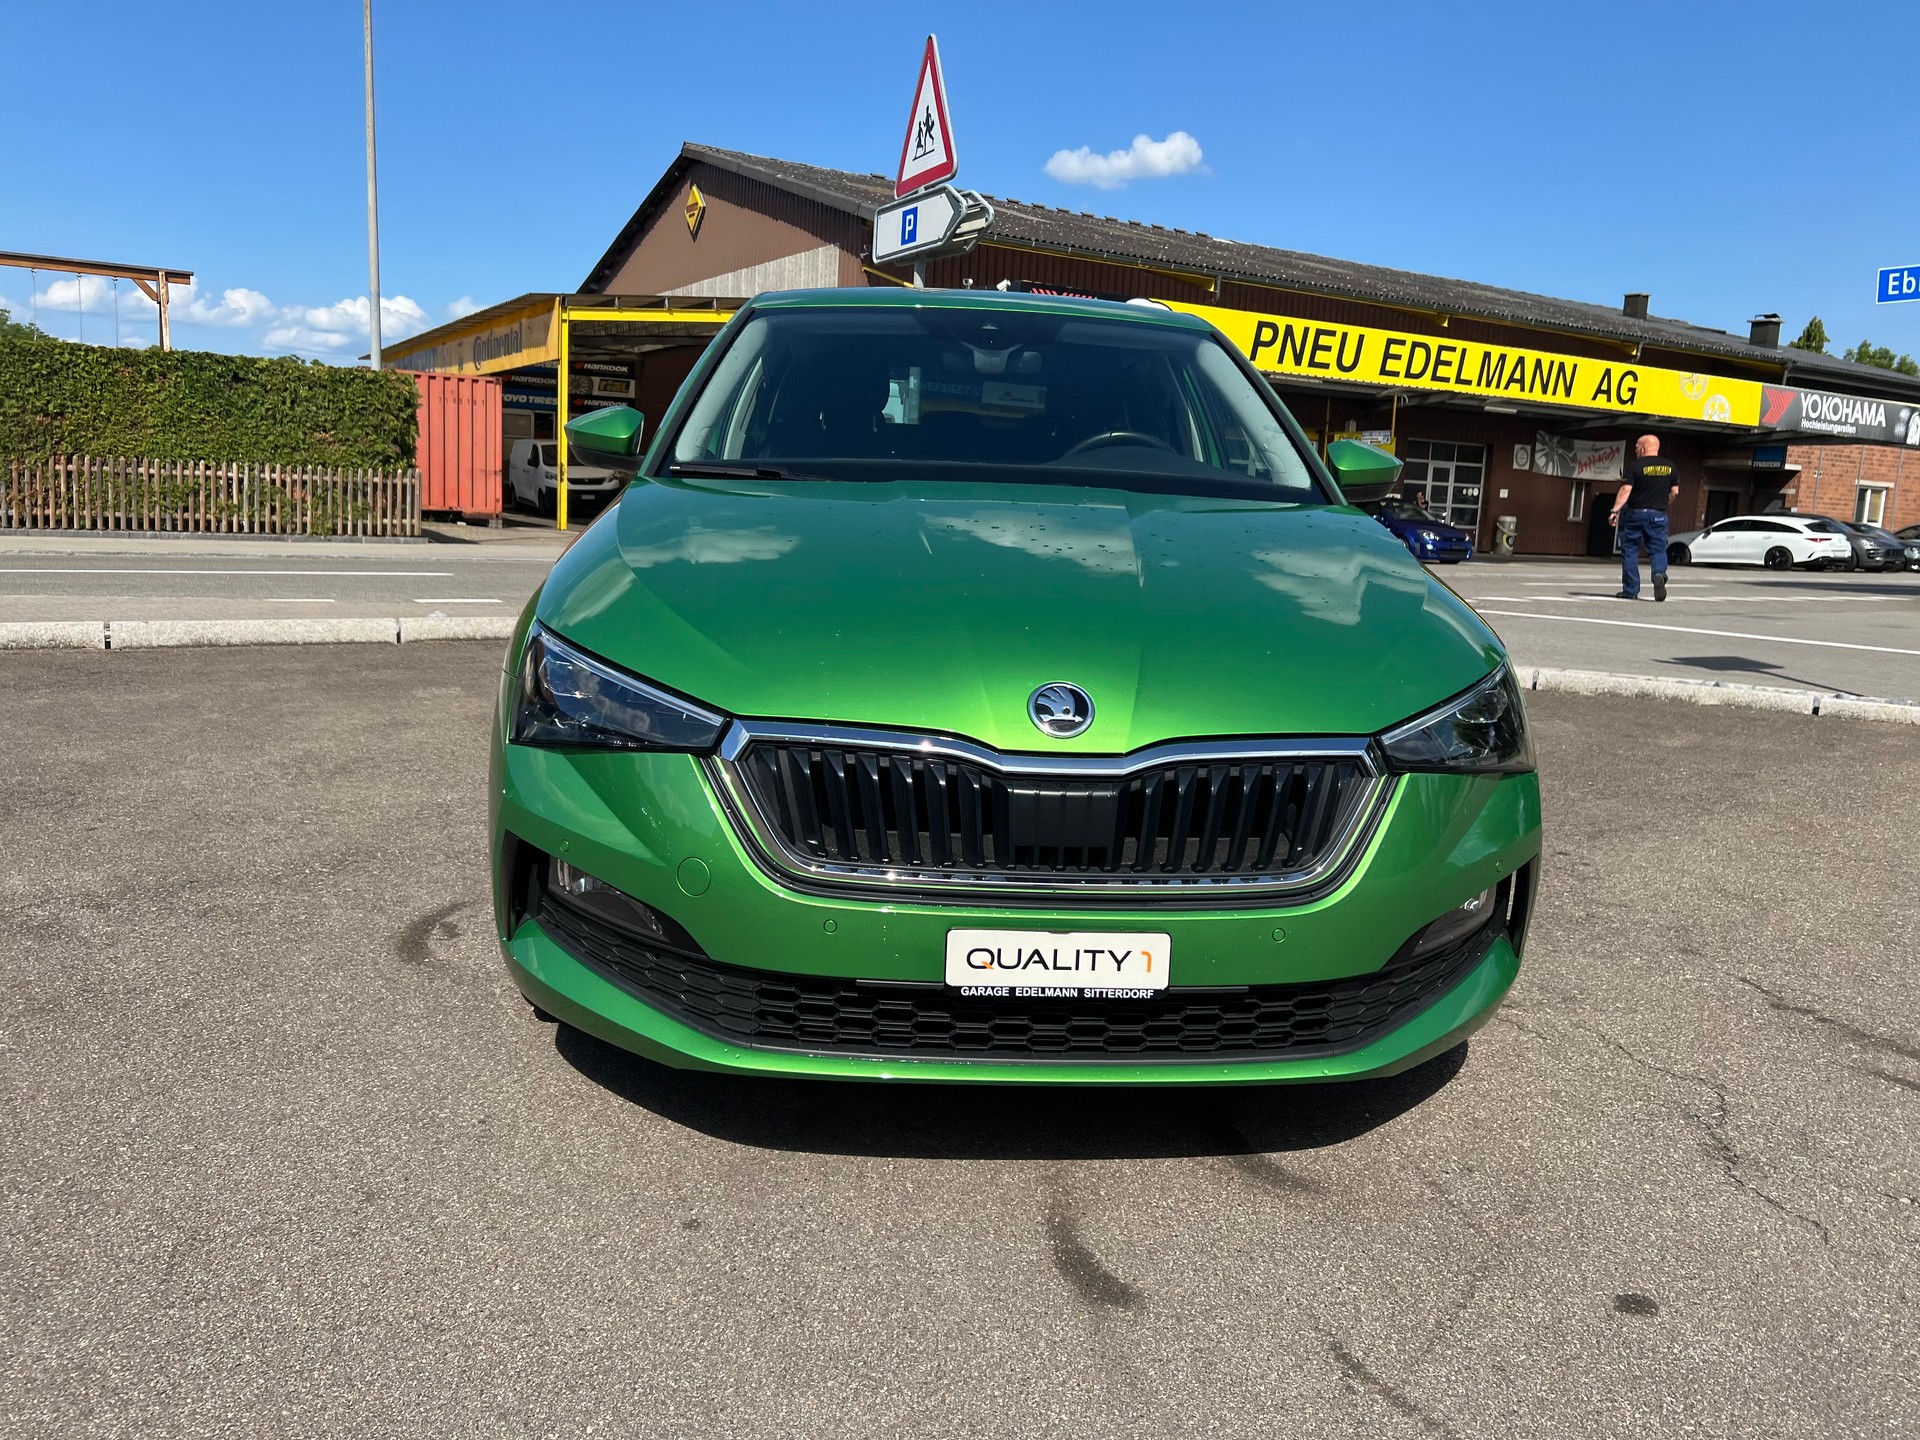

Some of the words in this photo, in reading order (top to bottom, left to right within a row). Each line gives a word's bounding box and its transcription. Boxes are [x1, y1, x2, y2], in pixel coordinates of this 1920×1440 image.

[905, 214, 915, 240] P
[1888, 270, 1920, 295] Eb
[473, 321, 523, 371] Continental
[1250, 320, 1365, 373] PNEU
[1378, 337, 1578, 399] EDELMANN
[1592, 368, 1639, 406] AG
[503, 393, 528, 403] OYO
[1800, 392, 1887, 428] YOKOHAMA
[1801, 418, 1857, 434] Hochleistungsreifen
[966, 947, 1132, 972] QUALITY
[1141, 951, 1152, 973] 1
[960, 986, 1010, 997] GARAGE
[1015, 987, 1078, 998] EDELMANN
[1084, 988, 1155, 999] SITTERDORF
